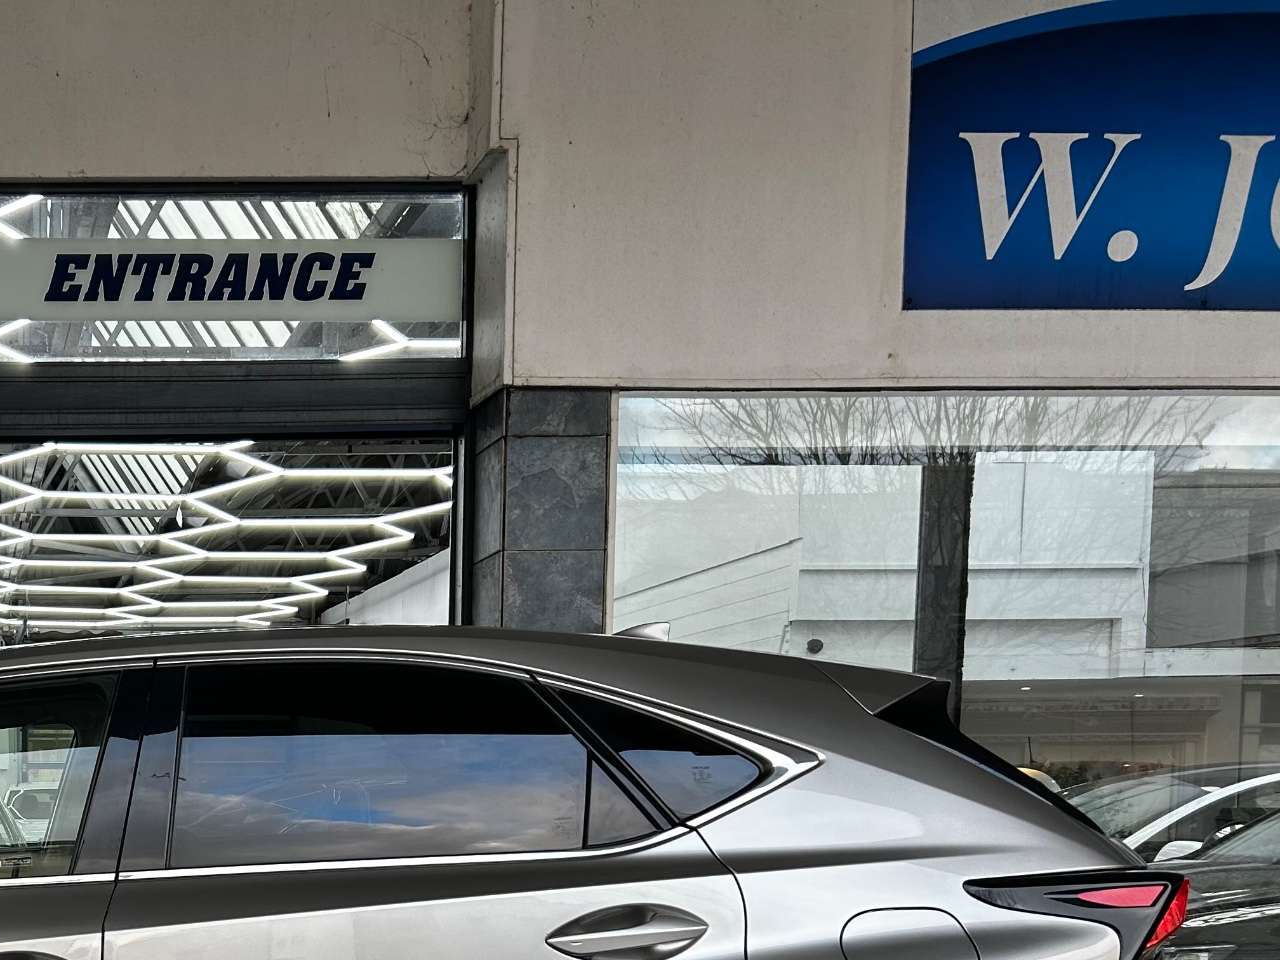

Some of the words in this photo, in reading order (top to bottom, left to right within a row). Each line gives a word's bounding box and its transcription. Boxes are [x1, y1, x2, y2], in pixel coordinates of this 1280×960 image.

[958, 131, 1143, 263] W.
[1183, 134, 1280, 291] J
[43, 251, 376, 302] ENTRANCE
